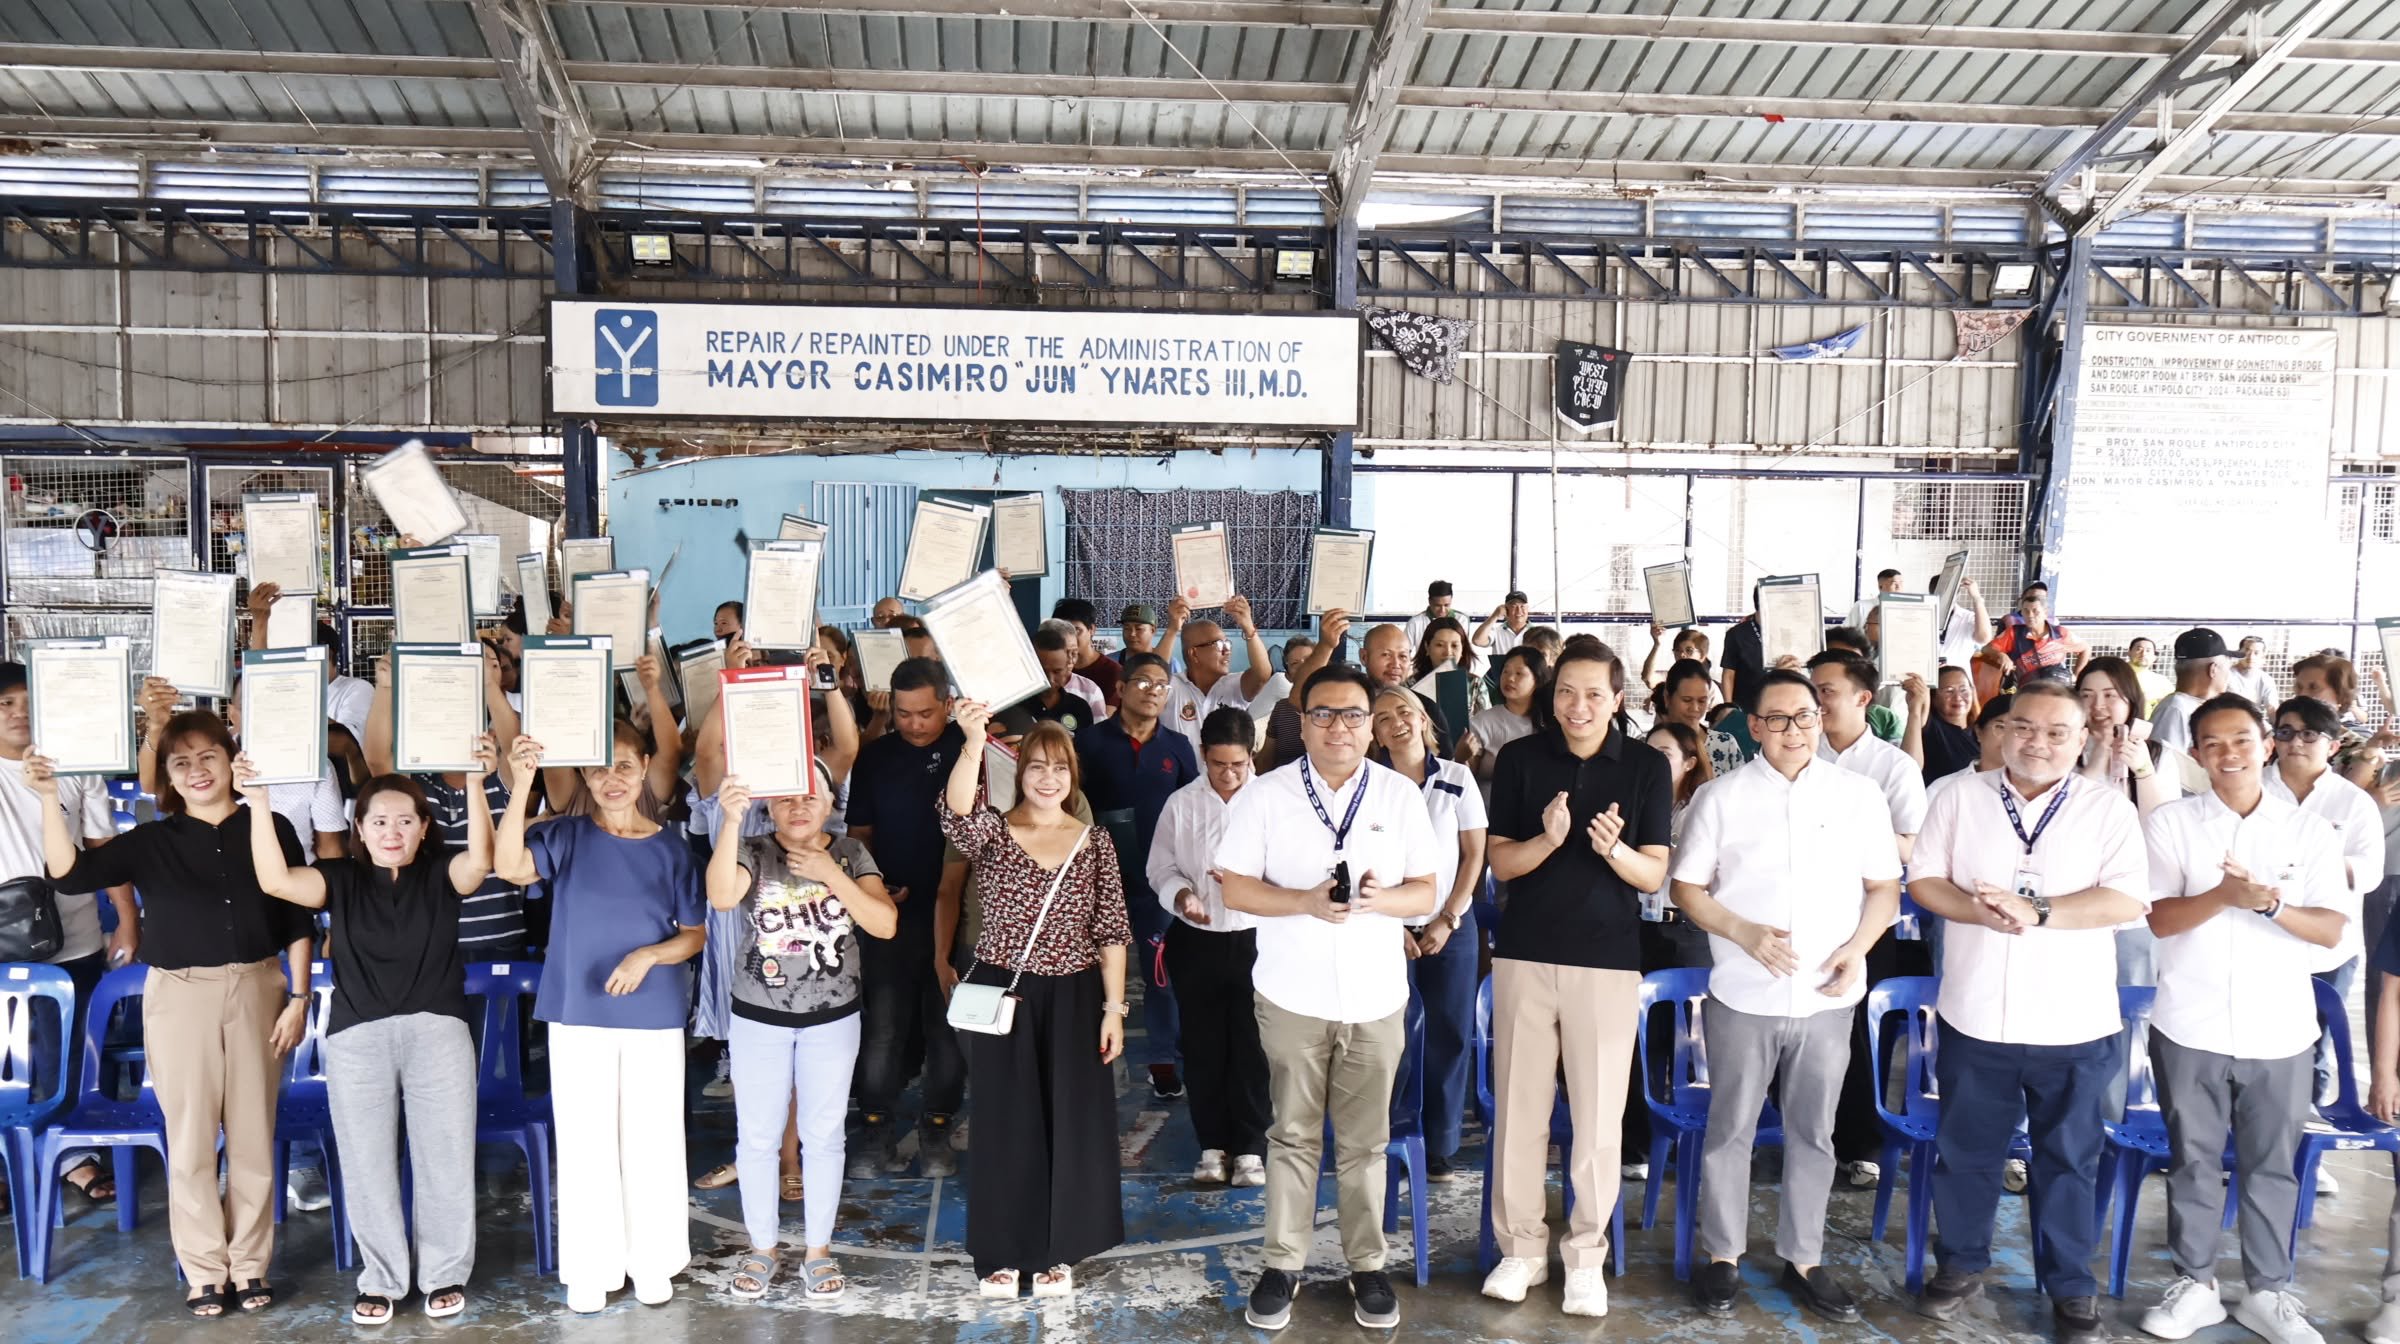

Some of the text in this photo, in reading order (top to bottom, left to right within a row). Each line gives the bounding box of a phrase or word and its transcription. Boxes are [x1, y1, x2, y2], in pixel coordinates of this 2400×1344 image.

[944, 335, 1010, 357] UNDER
[1025, 336, 1064, 358] THE
[1080, 337, 1271, 363] ADMINISTRATION
[1278, 341, 1304, 363] OF
[2096, 330, 2301, 346] CITY GOVERNMENT OF ANTIPOLO
[707, 359, 831, 390] MAYOR
[854, 361, 1009, 392] CASIMIRO
[1100, 366, 1211, 396] YNARES
[758, 894, 848, 933] CHIC
